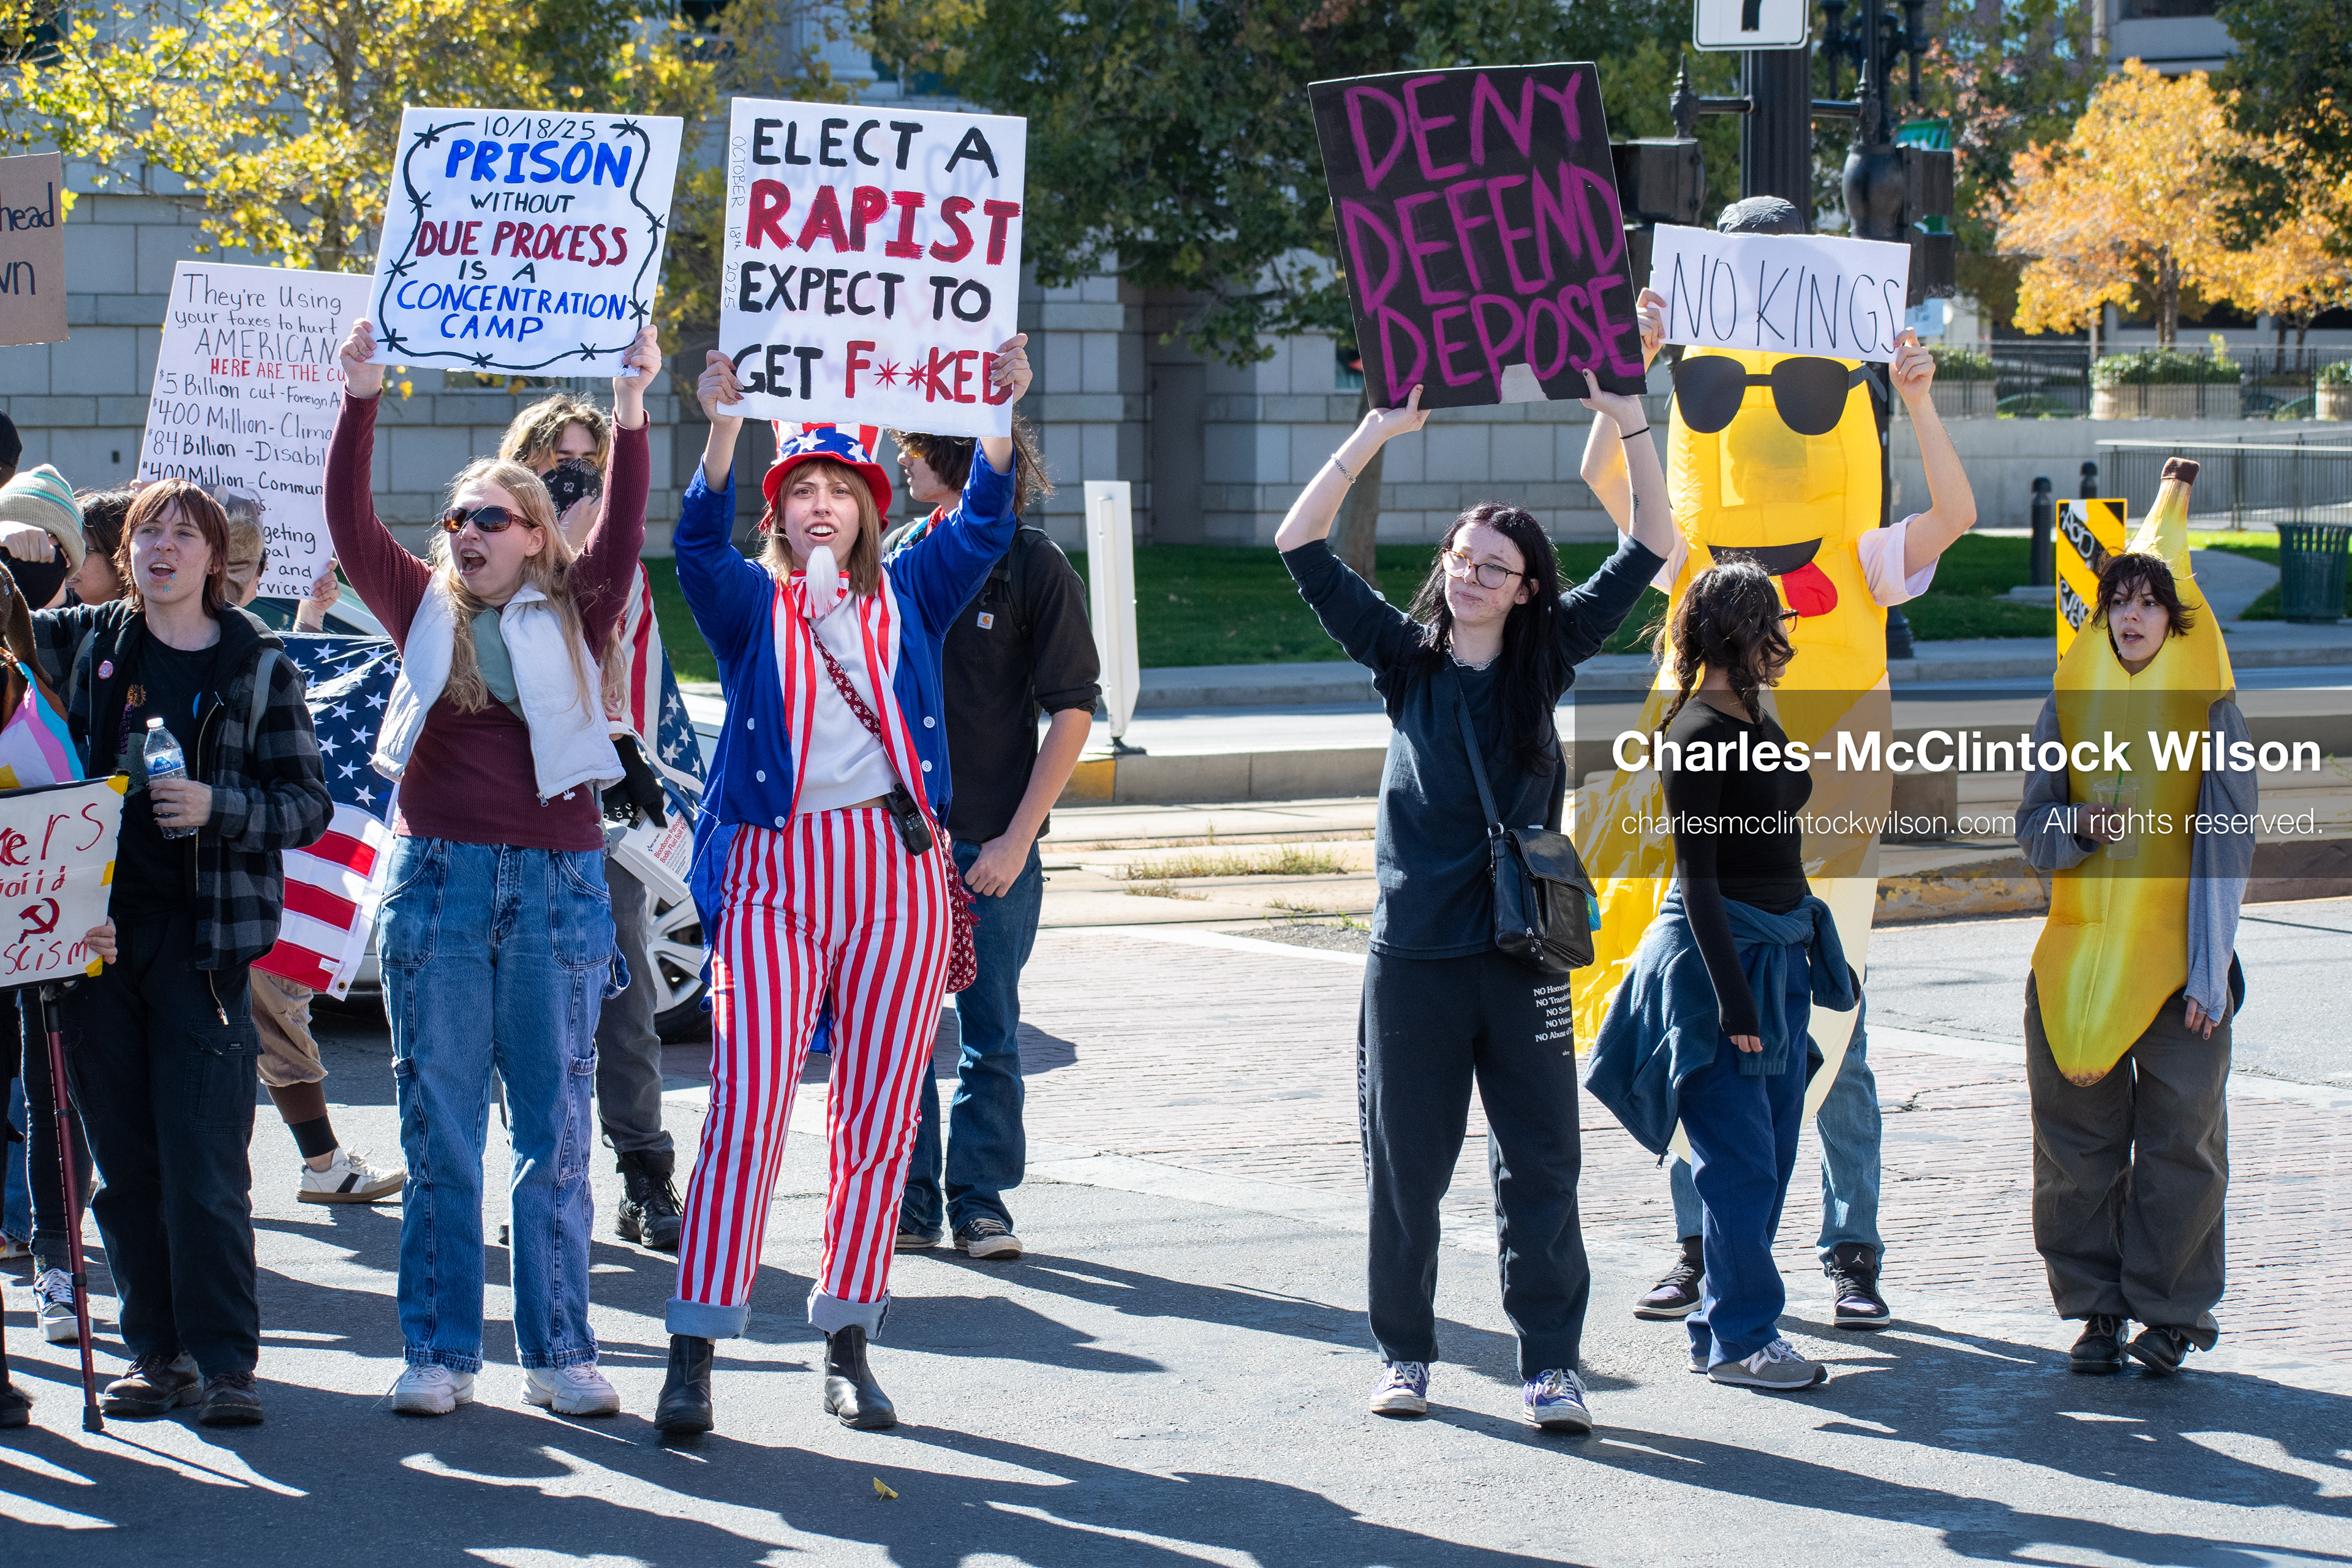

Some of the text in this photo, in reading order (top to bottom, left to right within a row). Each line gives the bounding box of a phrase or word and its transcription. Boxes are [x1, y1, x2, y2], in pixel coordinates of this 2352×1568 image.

[484, 116, 595, 140] 10/18/25
[1344, 72, 1581, 190] DENY
[446, 139, 632, 187] PRISON
[753, 118, 999, 178] ELECT A
[731, 137, 746, 208] OCTOBER
[470, 192, 575, 213] WITHOUT
[746, 178, 1022, 265] RAPIST
[416, 221, 628, 267] DUE PROCESS
[1341, 158, 1626, 317] DEFEND
[459, 259, 535, 284] IS A
[725, 262, 739, 309] 2025
[183, 273, 341, 313] They're Using
[397, 280, 627, 320] CONCENTRATION
[740, 261, 905, 319] EXPECT
[930, 276, 990, 322] TO
[1670, 252, 1899, 353] NO KINGS
[175, 310, 338, 335] your taxes to hurt
[441, 313, 543, 342] CAMP
[1378, 274, 1644, 405] DEPOSE
[185, 374, 239, 399] Billion
[250, 383, 275, 399] cut
[211, 358, 251, 378] HERE
[257, 362, 285, 379] ARE
[288, 364, 321, 382] THE
[731, 343, 823, 399] GET
[184, 434, 236, 458] Billion
[279, 565, 312, 579] and
[654, 832, 672, 859] Bloodborne
[669, 813, 685, 835] Pathogen
[660, 848, 673, 864] Bodily
[668, 837, 678, 850] Fluid
[674, 828, 685, 840] Spill
[1533, 987, 1546, 997] NO
[1536, 998, 1548, 1008] NO
[1545, 1019, 1558, 1028] NO
[1546, 1008, 1558, 1017] NO
[1535, 1033, 1548, 1042] NO
[1550, 1030, 1566, 1039] Abuse
